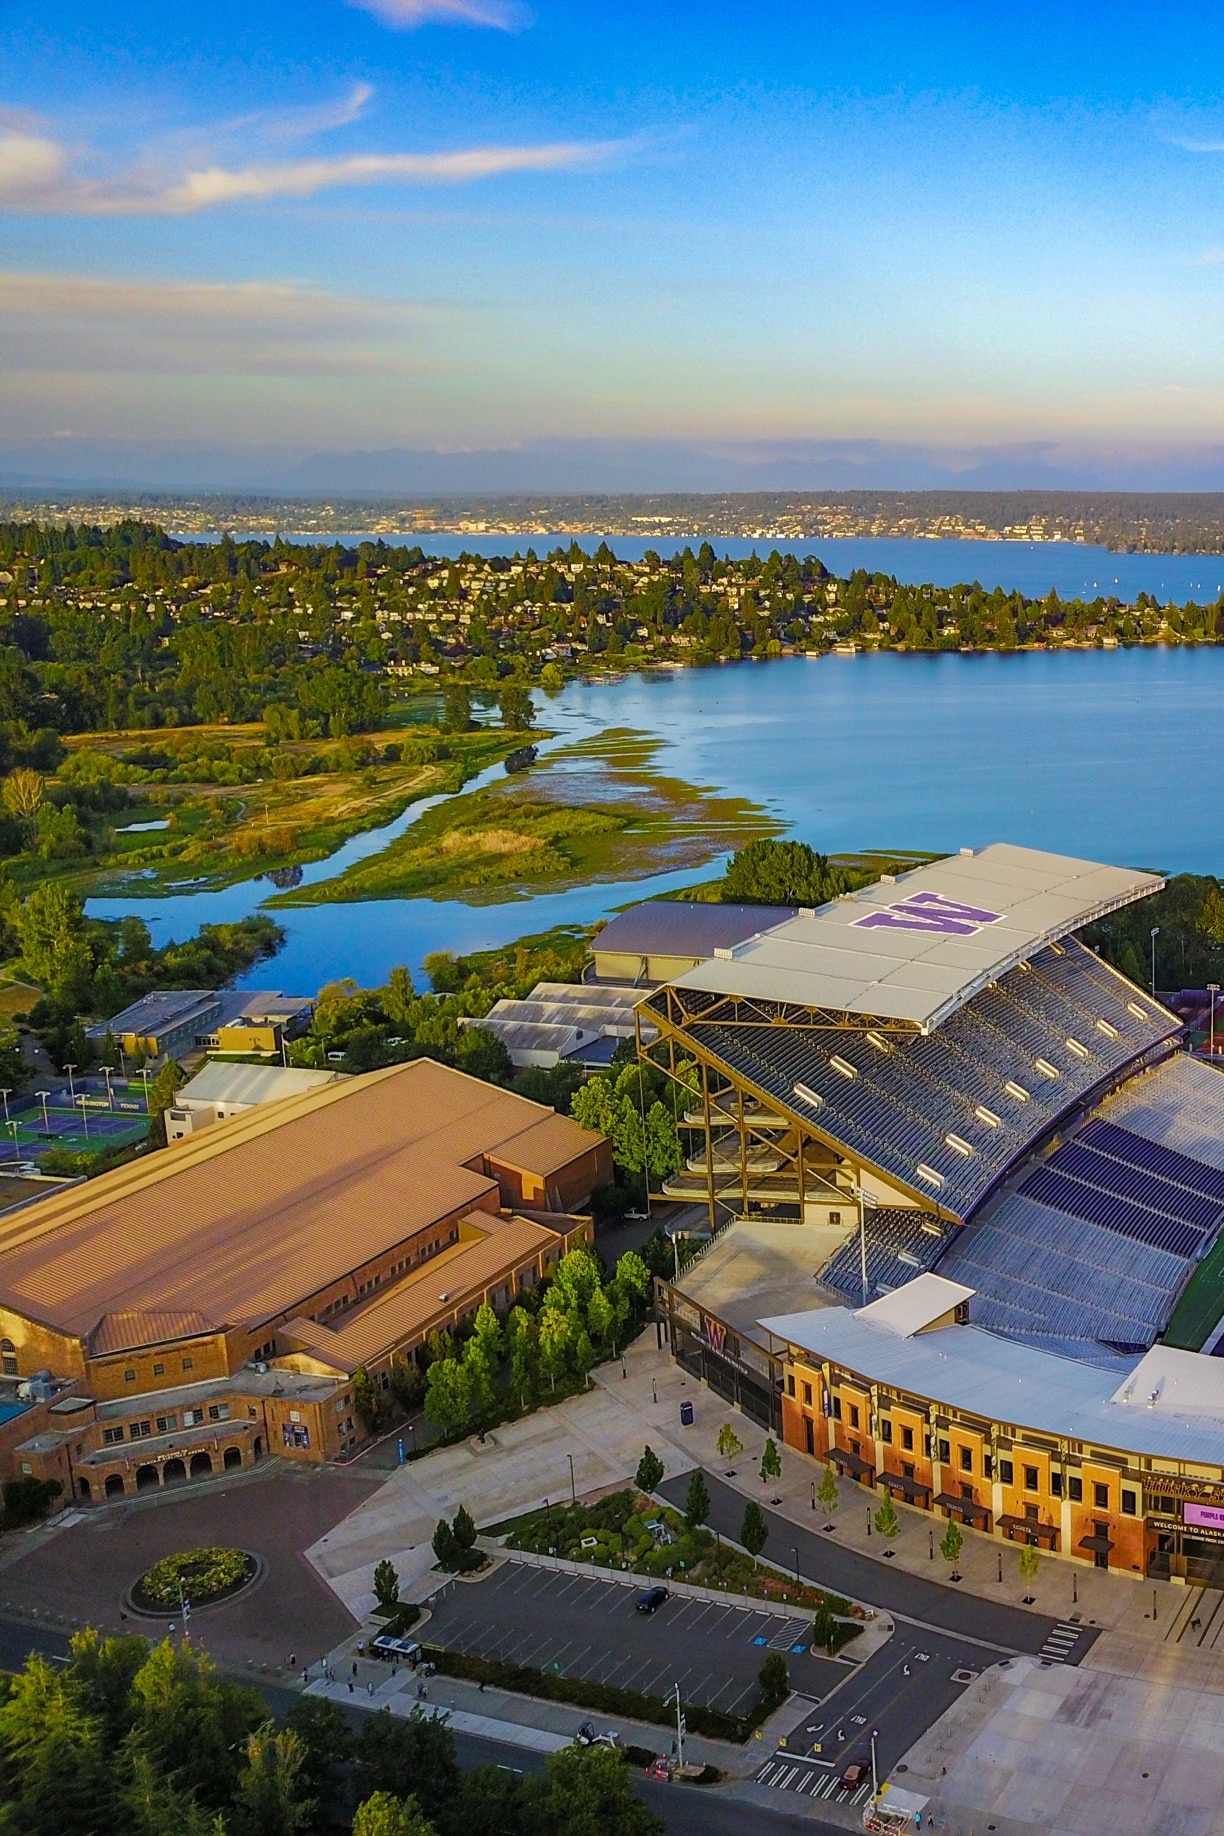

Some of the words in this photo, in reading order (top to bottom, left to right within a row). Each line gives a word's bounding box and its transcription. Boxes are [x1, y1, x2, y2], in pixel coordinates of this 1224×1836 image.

[848, 891, 1008, 936] W
[704, 1315, 727, 1353] W
[1144, 1479, 1206, 1499] HUSKY
[1200, 1511, 1218, 1520] PURPLE
[1154, 1521, 1188, 1532] WELCOME
[1190, 1526, 1198, 1534] TO
